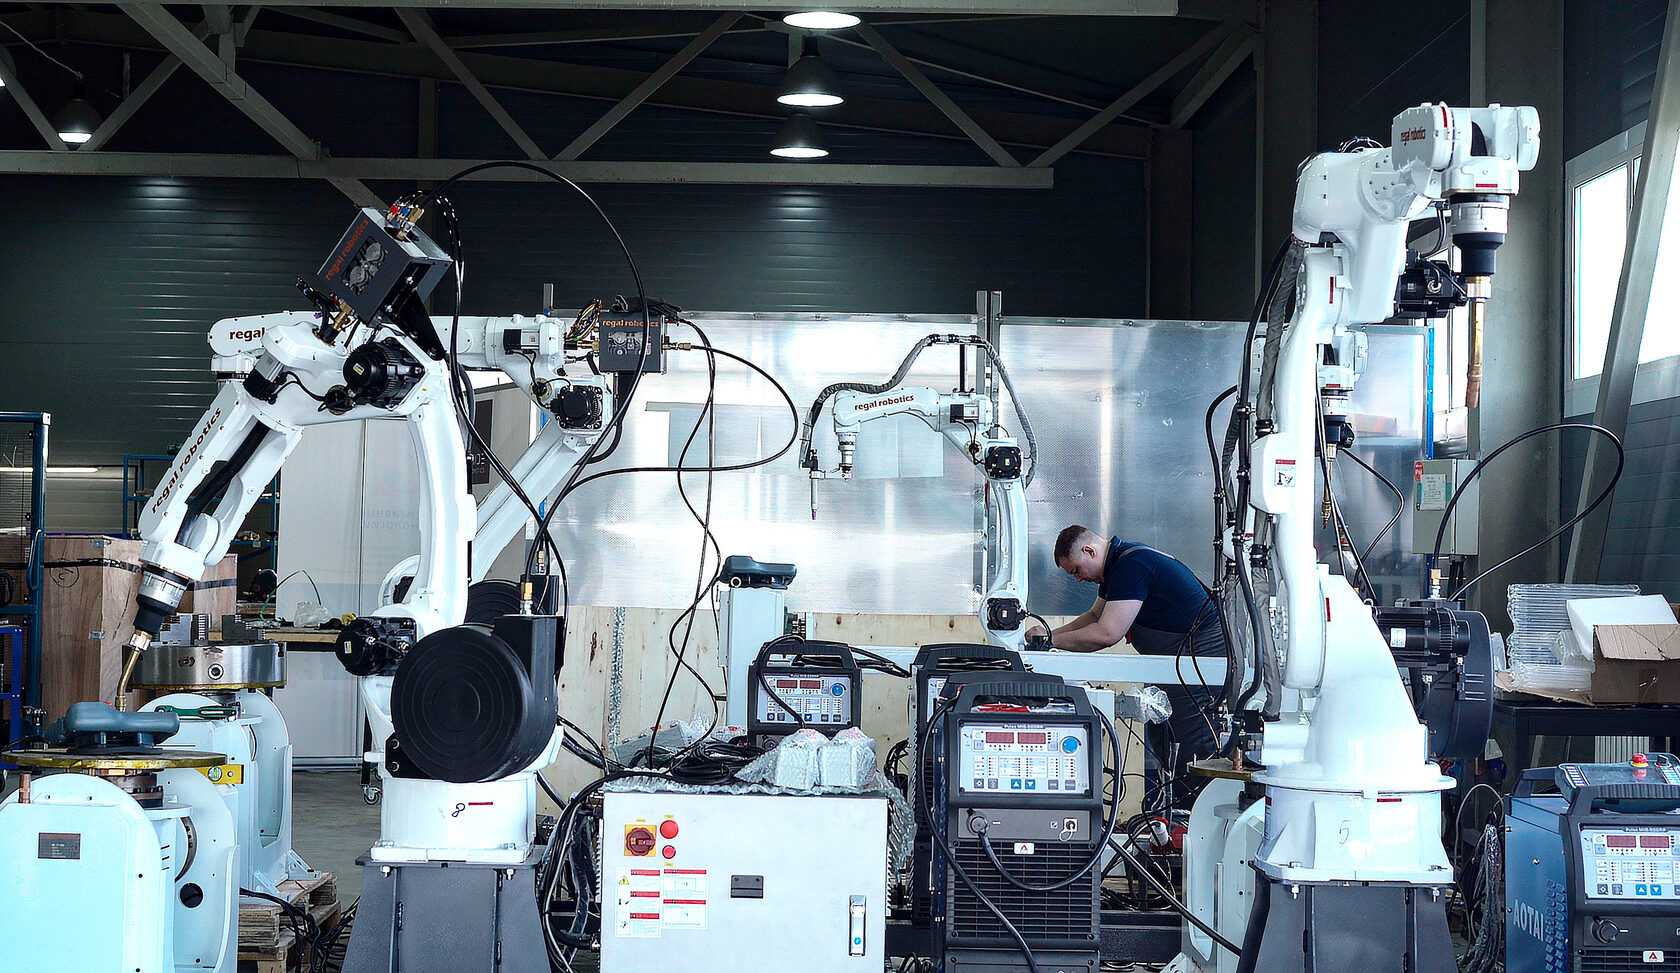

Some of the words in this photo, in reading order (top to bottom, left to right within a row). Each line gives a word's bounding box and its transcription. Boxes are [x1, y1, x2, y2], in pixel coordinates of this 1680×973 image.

[325, 255, 344, 280] regal
[341, 219, 369, 257] robotics
[229, 326, 266, 342] regal
[602, 319, 624, 328] regal
[624, 319, 660, 328] robocs
[854, 400, 878, 412] regal
[878, 394, 915, 407] robotics
[151, 470, 179, 514] regal
[179, 407, 222, 473] robotics
[1338, 819, 1351, 845] 5
[1513, 899, 1544, 942] AOTAI
